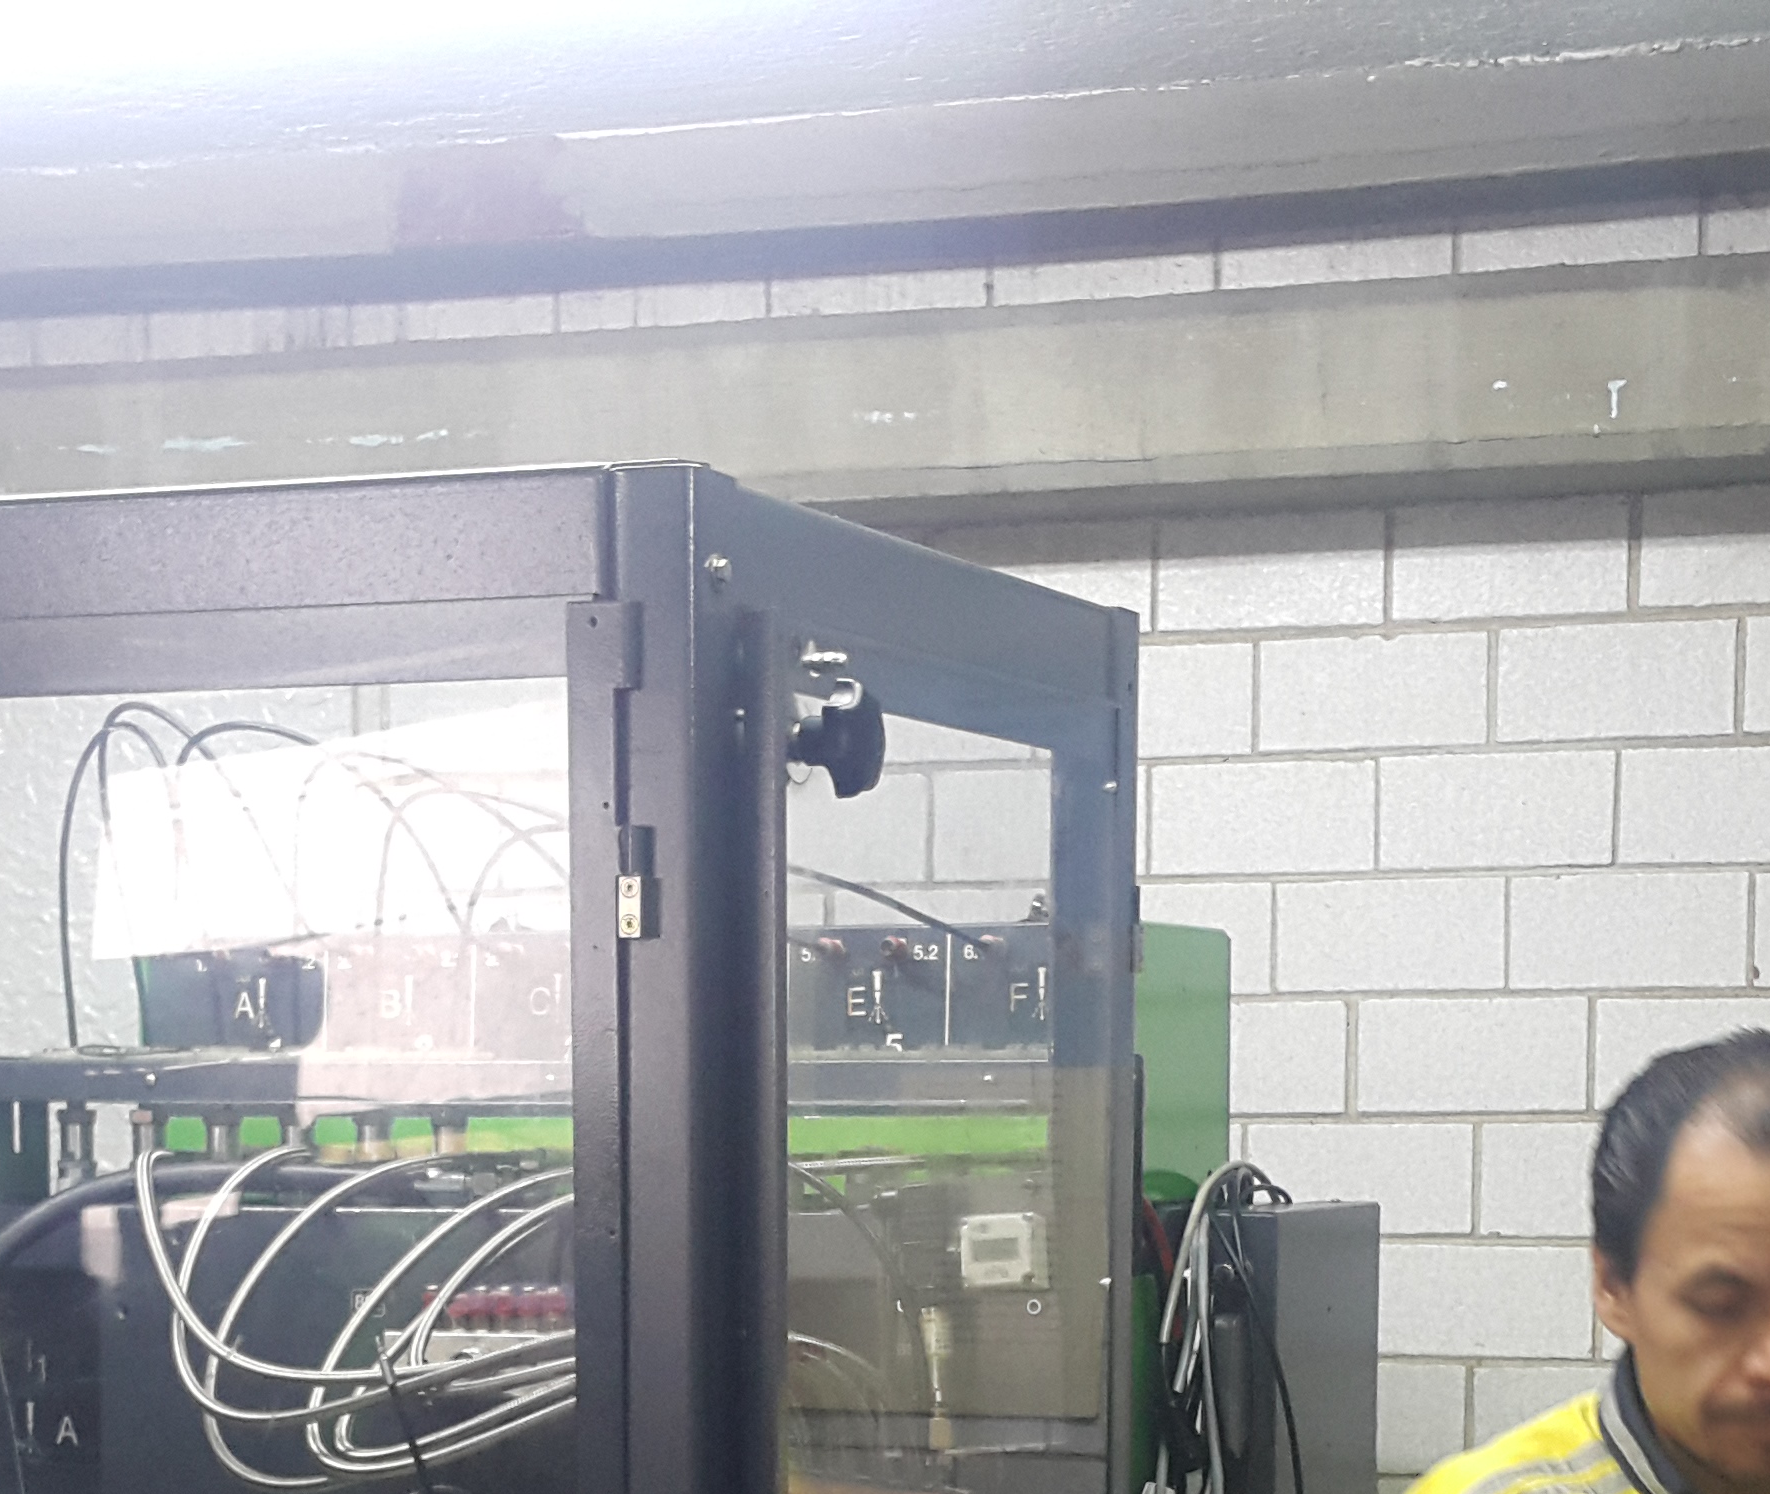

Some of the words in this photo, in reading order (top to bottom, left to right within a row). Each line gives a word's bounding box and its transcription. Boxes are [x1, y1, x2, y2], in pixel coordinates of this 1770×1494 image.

[912, 944, 939, 961] 5.2
[234, 991, 255, 1020] A
[379, 989, 403, 1019] B
[530, 987, 551, 1016] C
[846, 985, 868, 1017] E
[1010, 982, 1030, 1013] F
[56, 1415, 78, 1446] A
